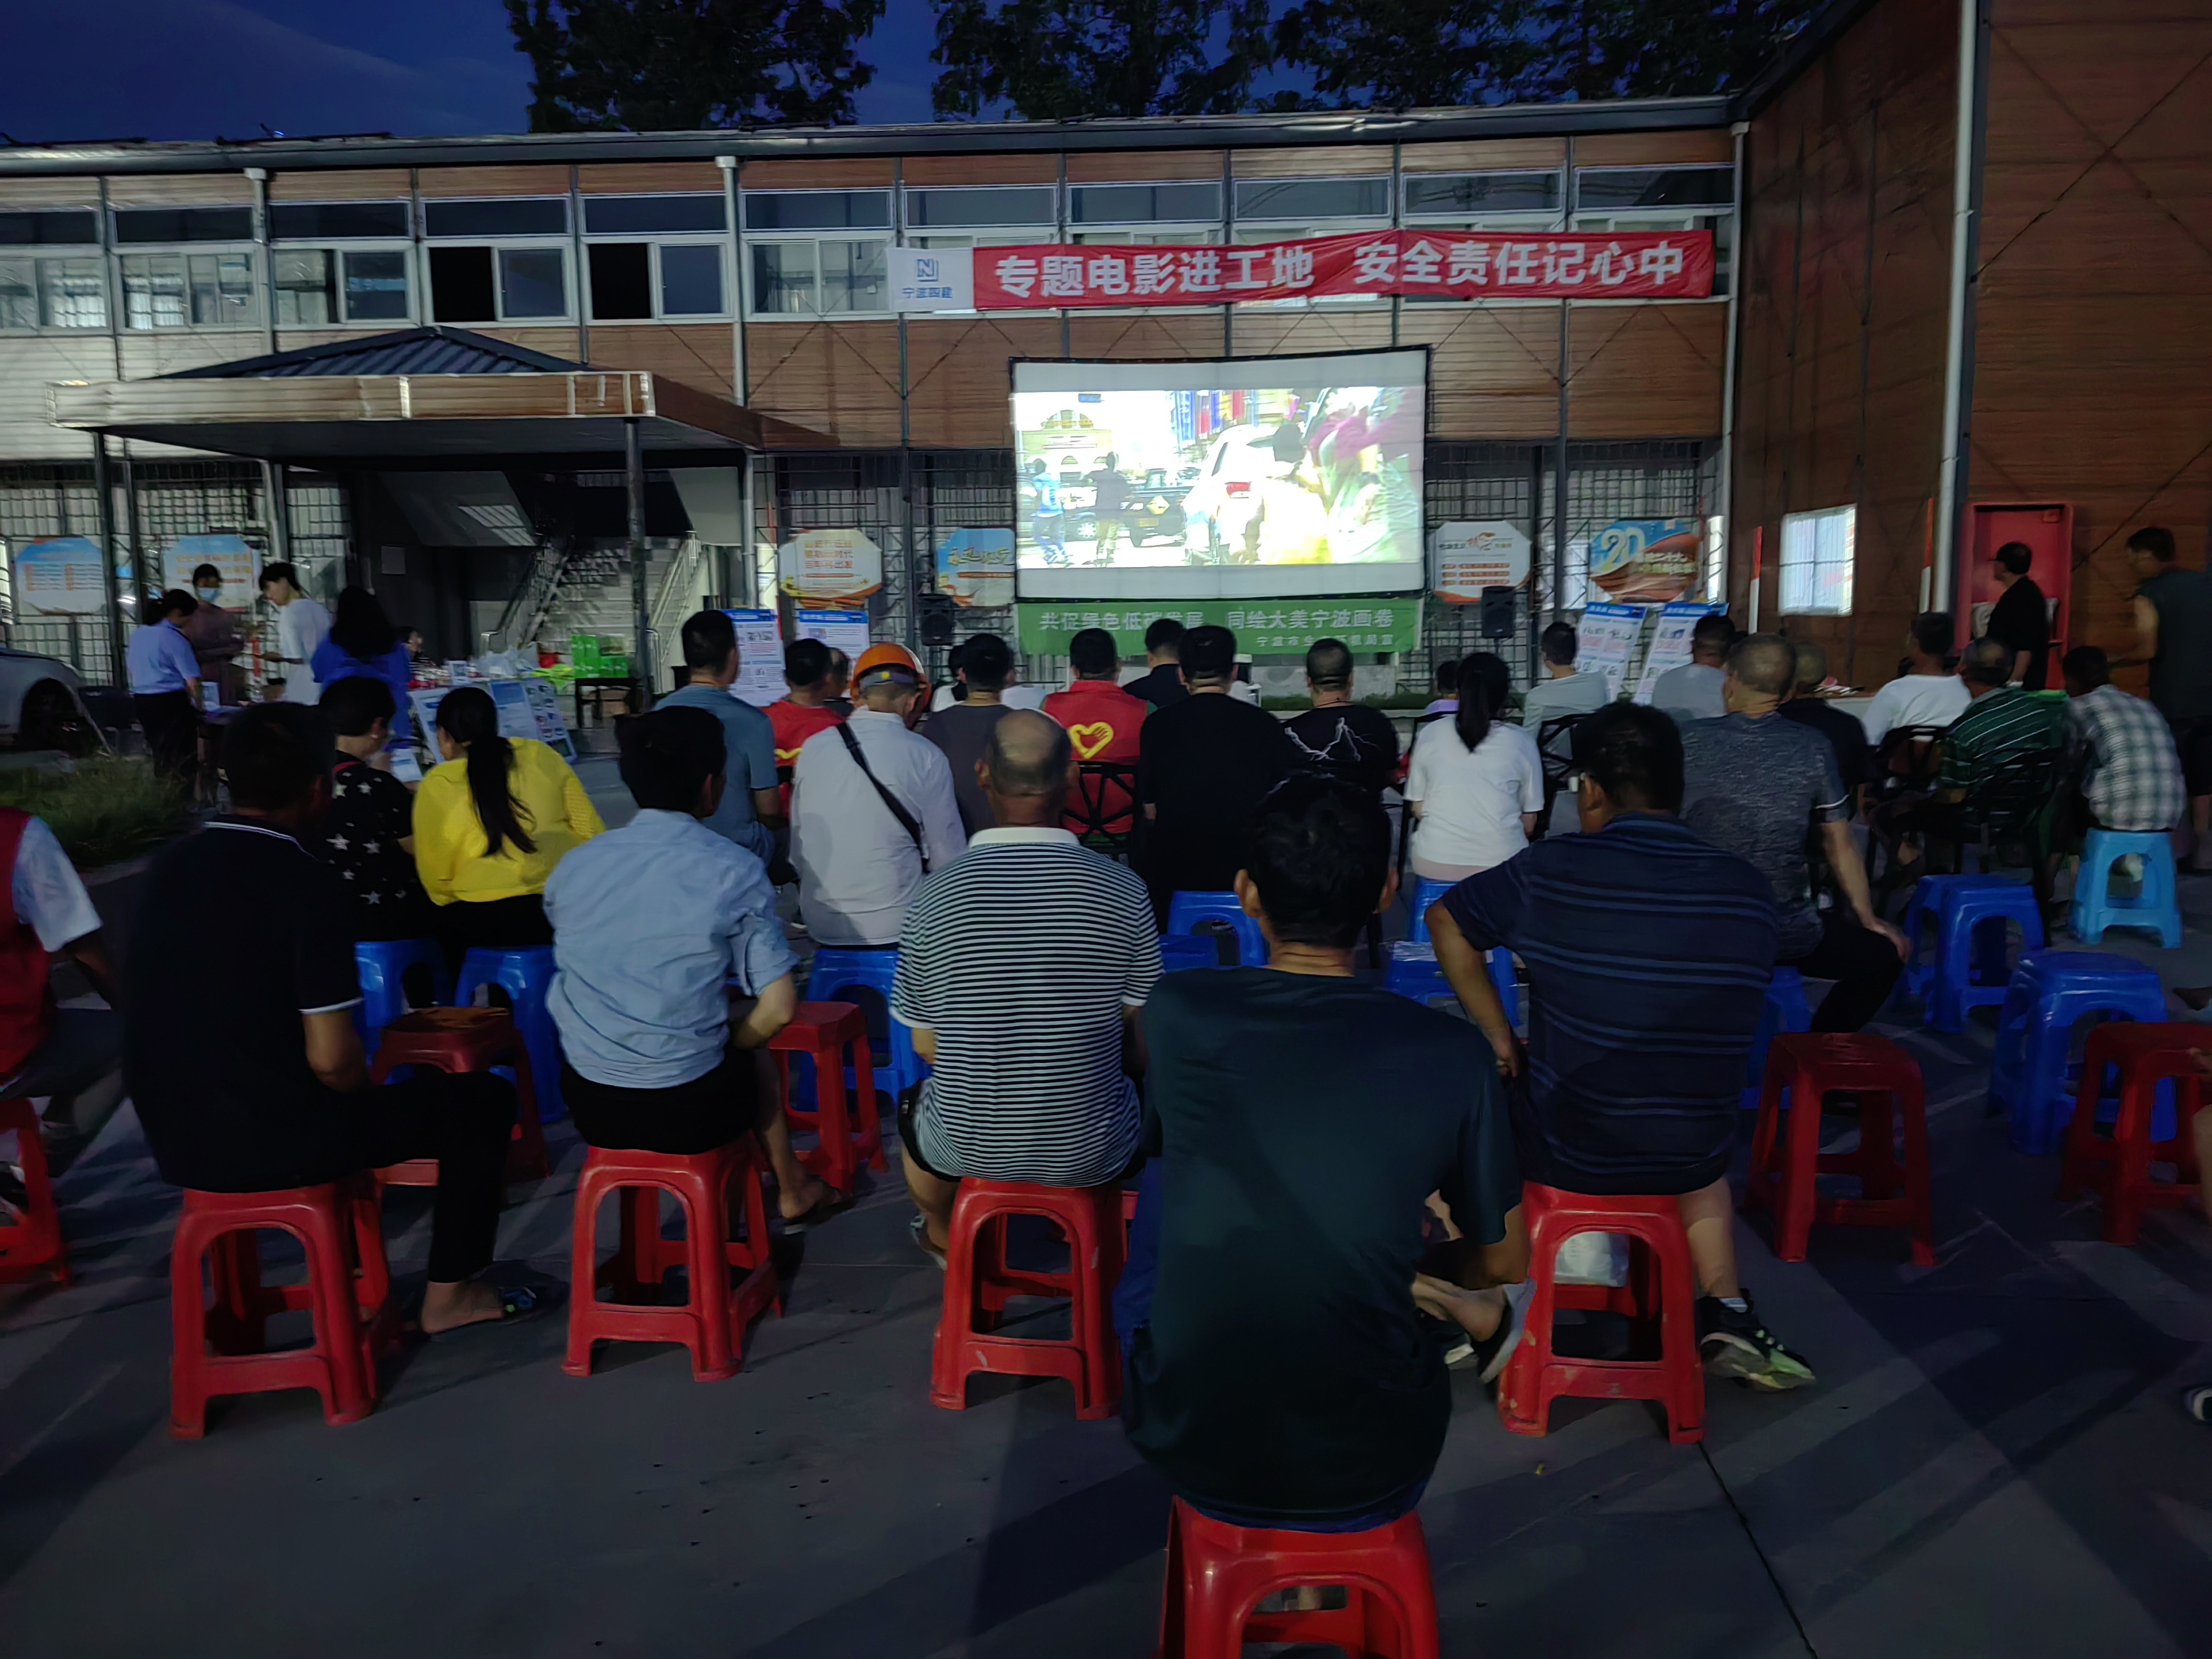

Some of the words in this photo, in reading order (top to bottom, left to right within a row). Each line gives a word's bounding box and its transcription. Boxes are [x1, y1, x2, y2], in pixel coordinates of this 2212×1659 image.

[995, 245, 1314, 298] 专题电影进工地
[1353, 240, 1684, 286] 安全责任记心中
[1228, 609, 1394, 629] 同绘大美宁波画卷
